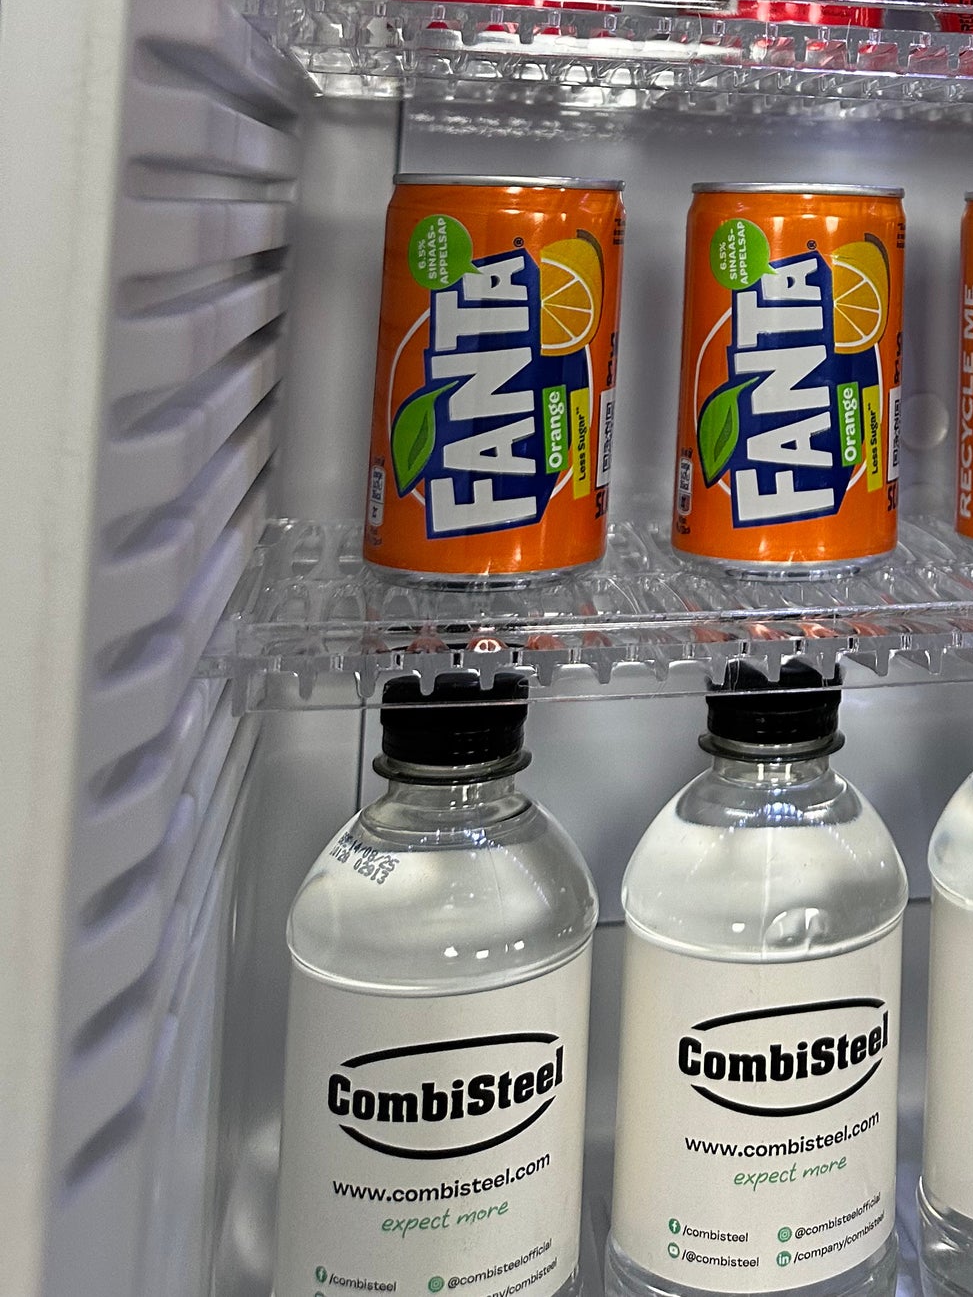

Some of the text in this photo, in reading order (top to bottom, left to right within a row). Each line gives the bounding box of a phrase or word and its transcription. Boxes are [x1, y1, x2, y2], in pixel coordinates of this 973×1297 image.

[427, 224, 437, 280] SINAAS-
[437, 217, 449, 284] APPELSAP
[719, 241, 728, 271] 6.5%
[727, 228, 738, 281] SINAAS-
[736, 221, 749, 285] APPELSAP
[430, 255, 538, 533] FANTA
[733, 257, 835, 522] FANTA
[546, 389, 565, 469] Orange
[841, 386, 861, 463] Orange
[577, 452, 587, 481] Less
[871, 446, 880, 475] Less
[677, 1009, 889, 1083] CombiSteel
[327, 1044, 565, 1123] CombiSteel
[684, 1111, 880, 1158] www.combisteel.com
[332, 1152, 551, 1202] www.combisteel.com
[733, 1155, 848, 1191] expect more
[381, 1200, 510, 1238] expect more
[682, 1224, 749, 1243] /combisteel
[793, 1211, 886, 1264] /company/combisteel
[794, 1191, 882, 1240] @combisteelofficial
[329, 1273, 397, 1292] /combisteel
[447, 1237, 553, 1290] @combisteelofficial
[681, 1248, 760, 1269] /@combisteel
